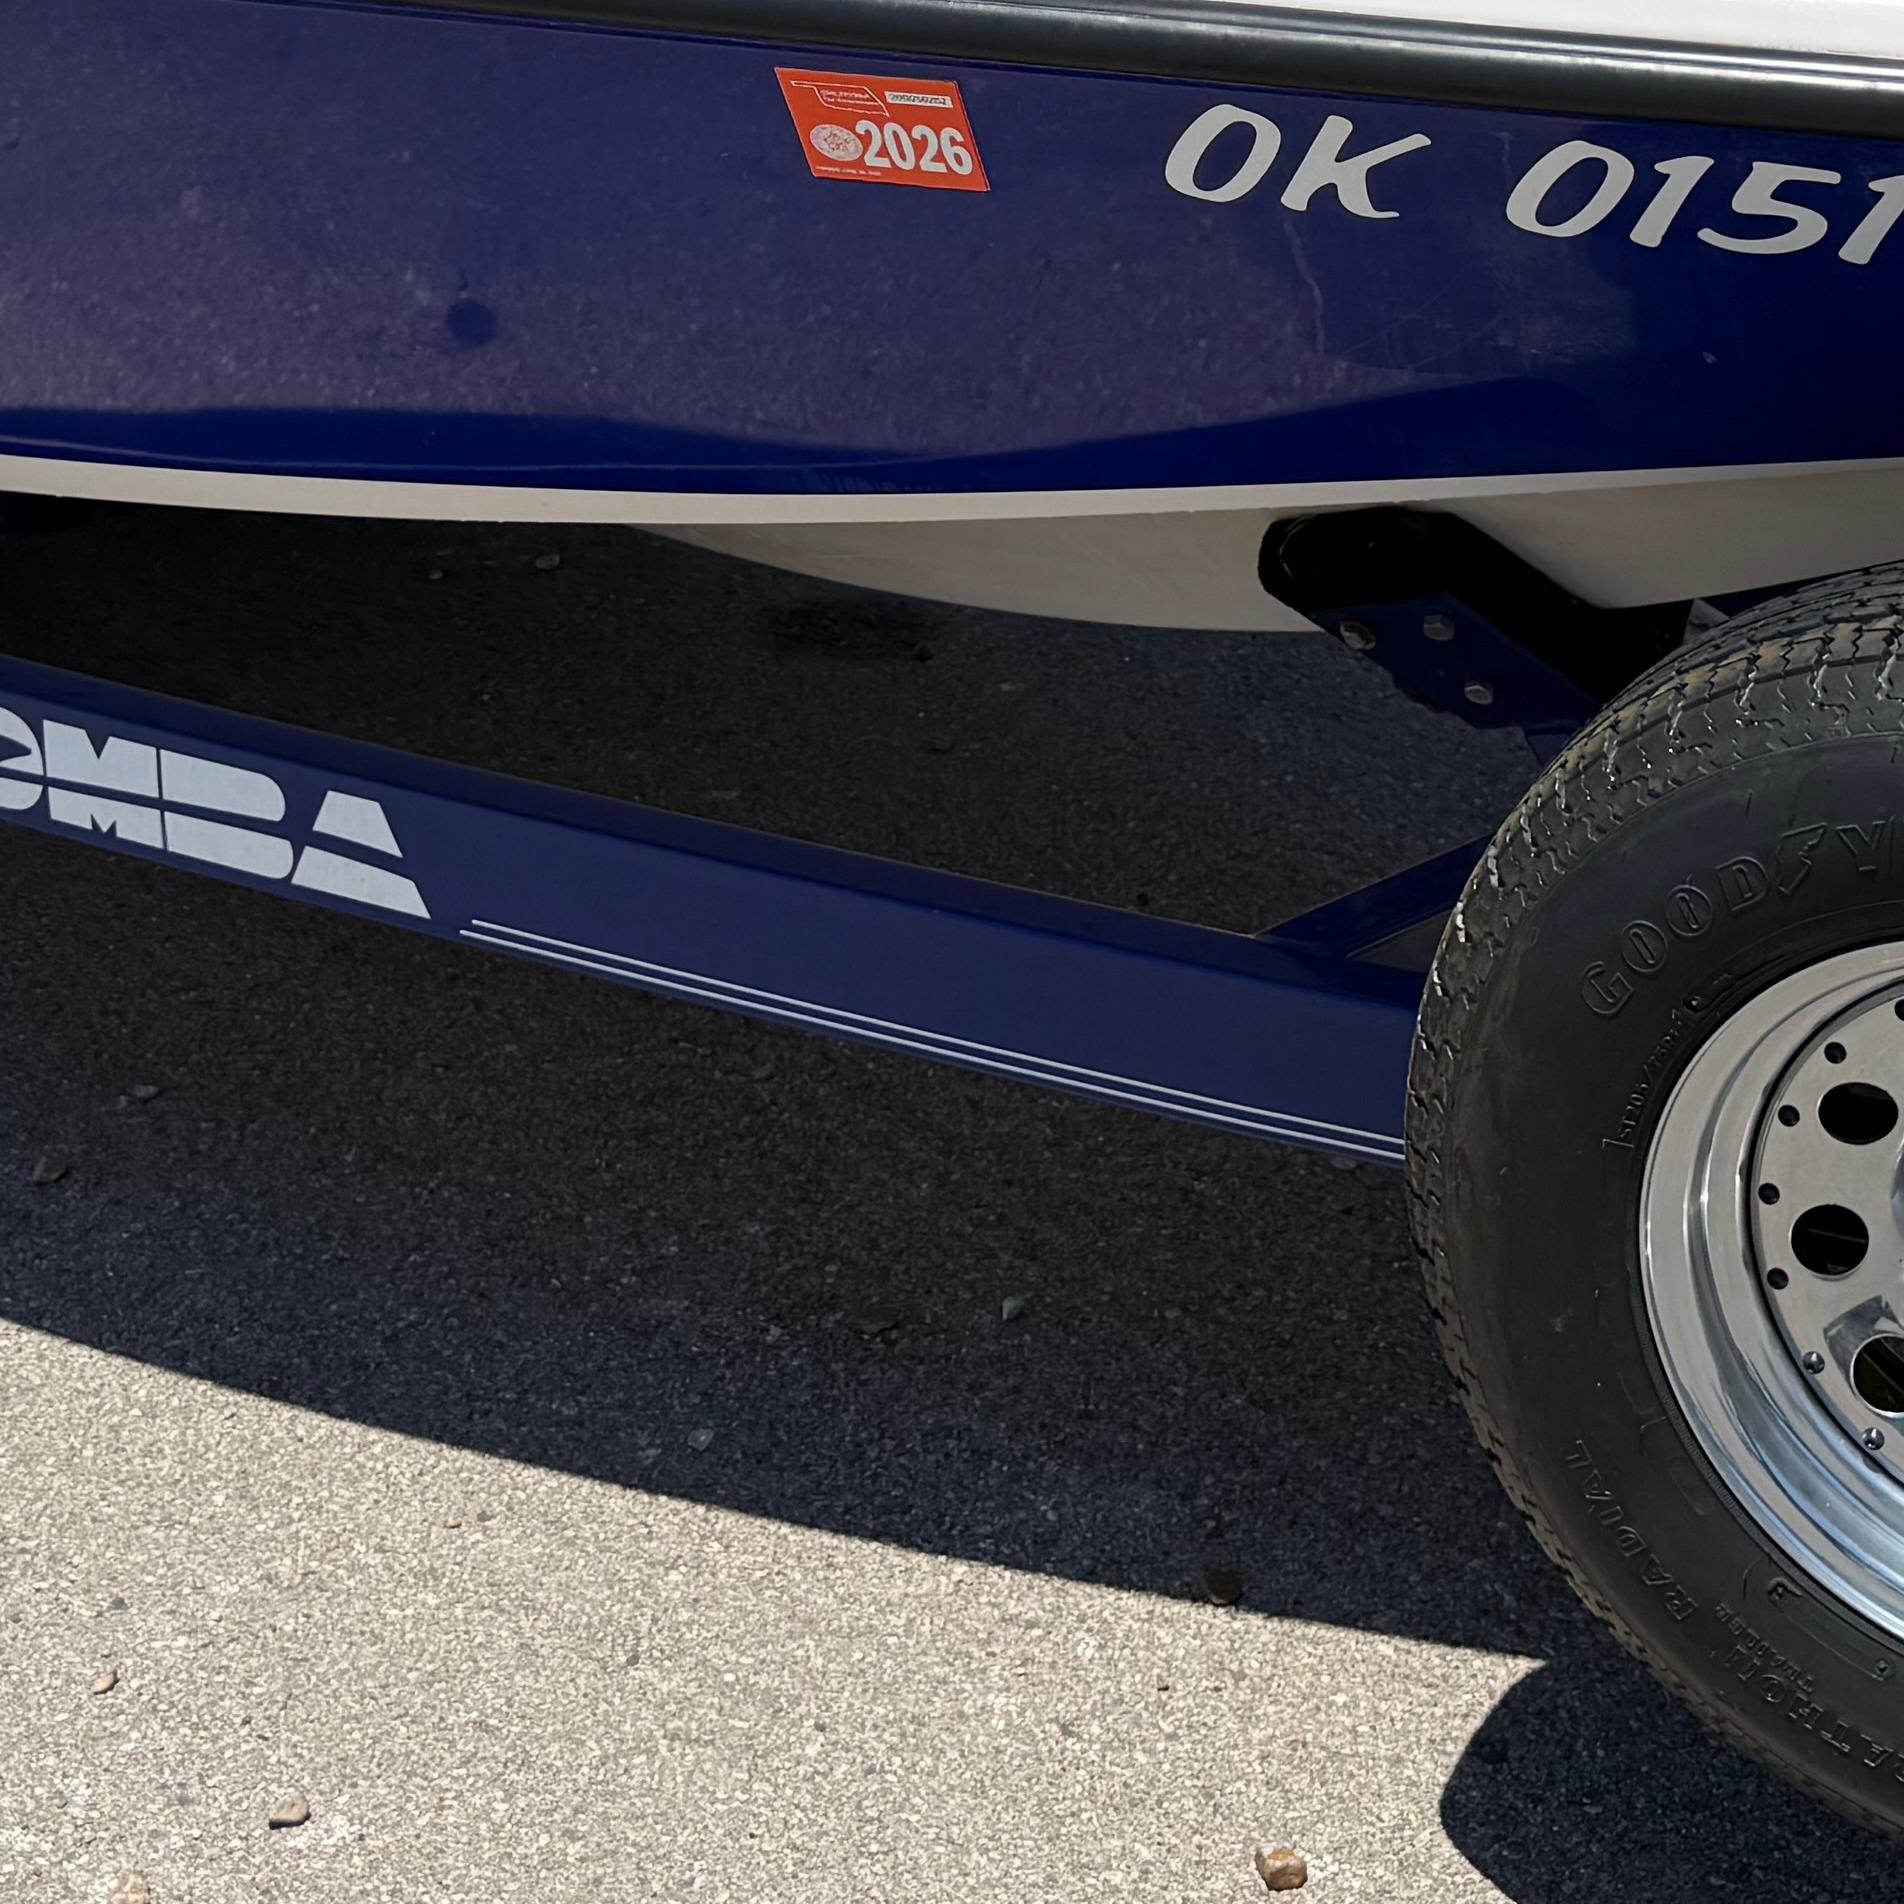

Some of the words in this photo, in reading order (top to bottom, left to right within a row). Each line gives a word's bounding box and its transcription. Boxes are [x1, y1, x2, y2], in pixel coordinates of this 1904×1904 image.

[854, 118, 974, 177] 2026
[1163, 103, 1432, 220] OK
[1565, 1438, 1700, 1622] RADIAL
